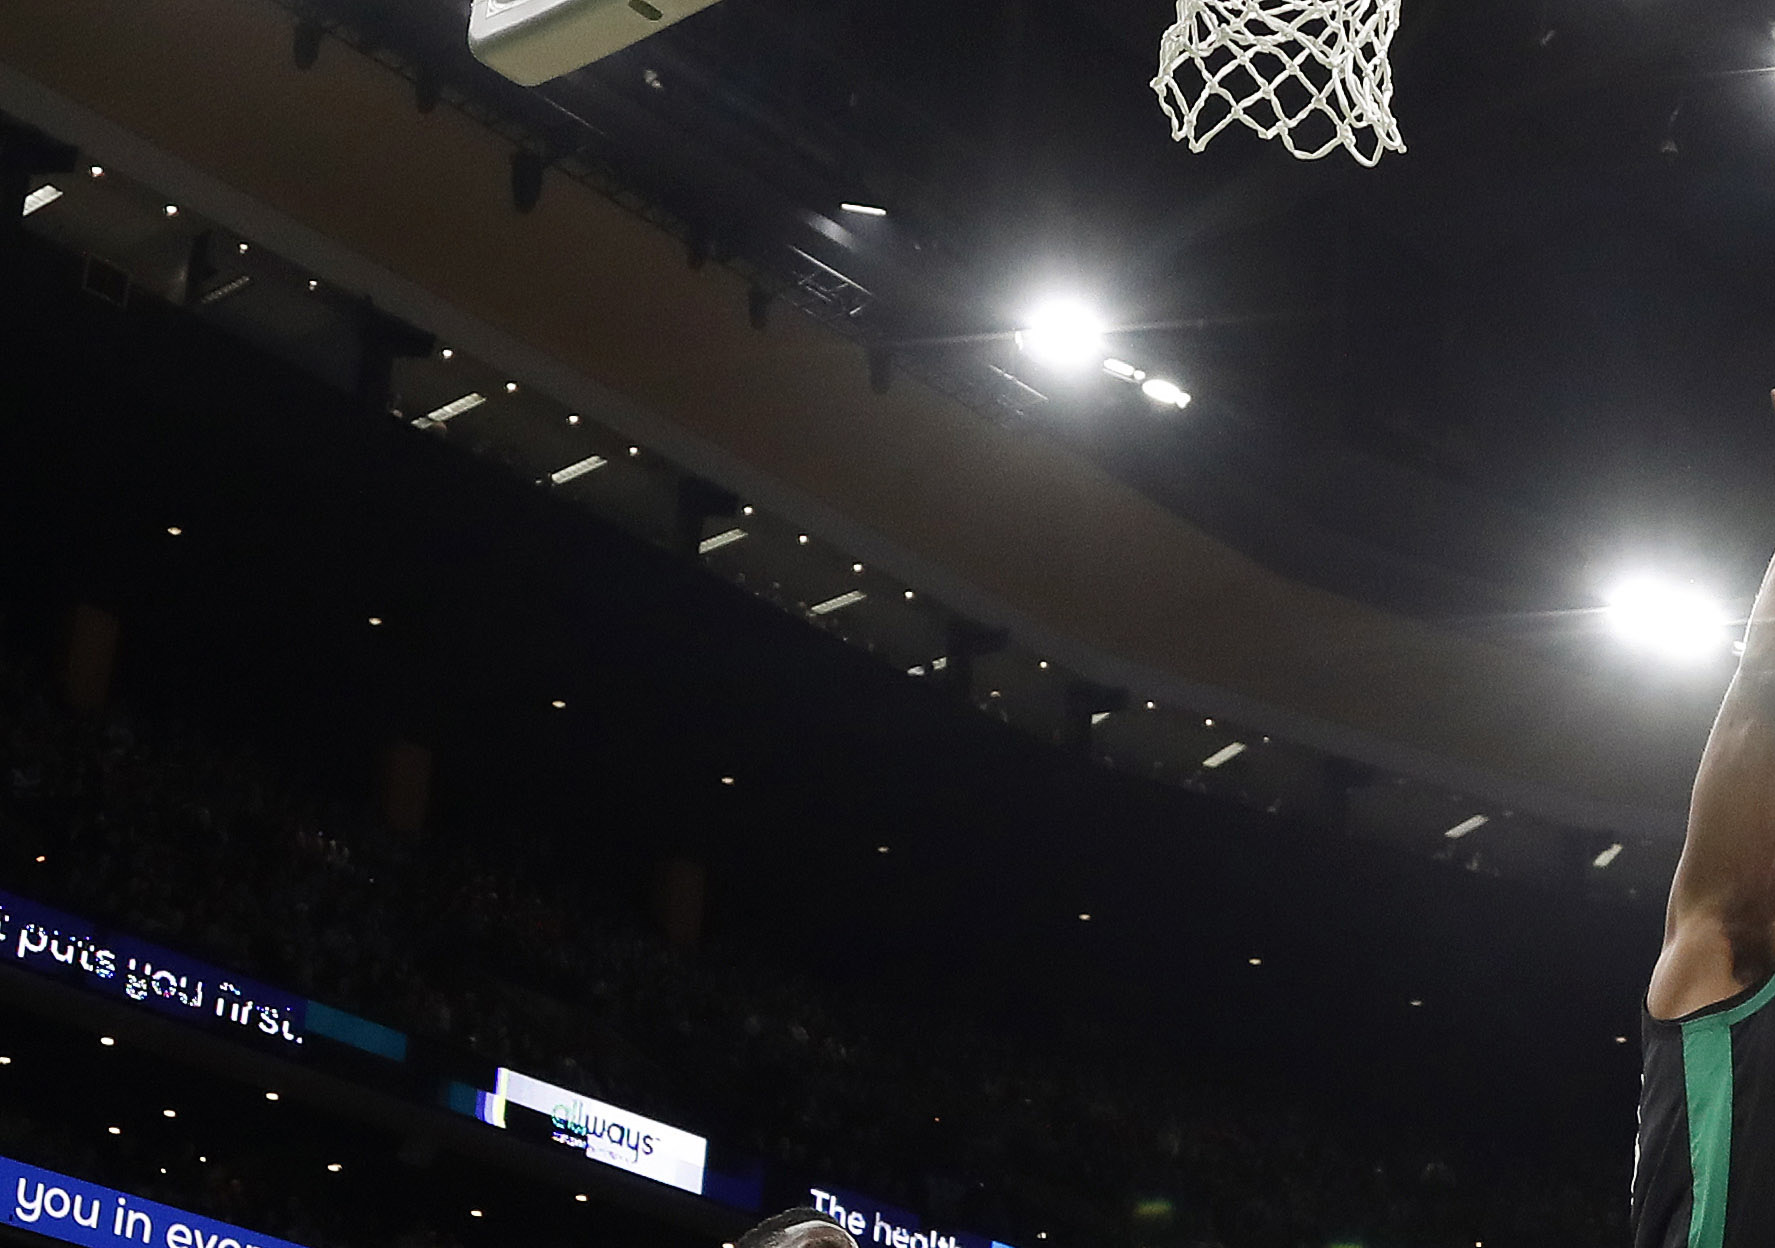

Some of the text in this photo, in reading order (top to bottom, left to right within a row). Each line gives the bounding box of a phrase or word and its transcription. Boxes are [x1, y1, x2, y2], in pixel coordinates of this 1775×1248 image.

[551, 1100, 655, 1164] allways
[14, 1177, 101, 1223] you
[113, 1197, 152, 1244] in
[810, 1188, 868, 1236] The
